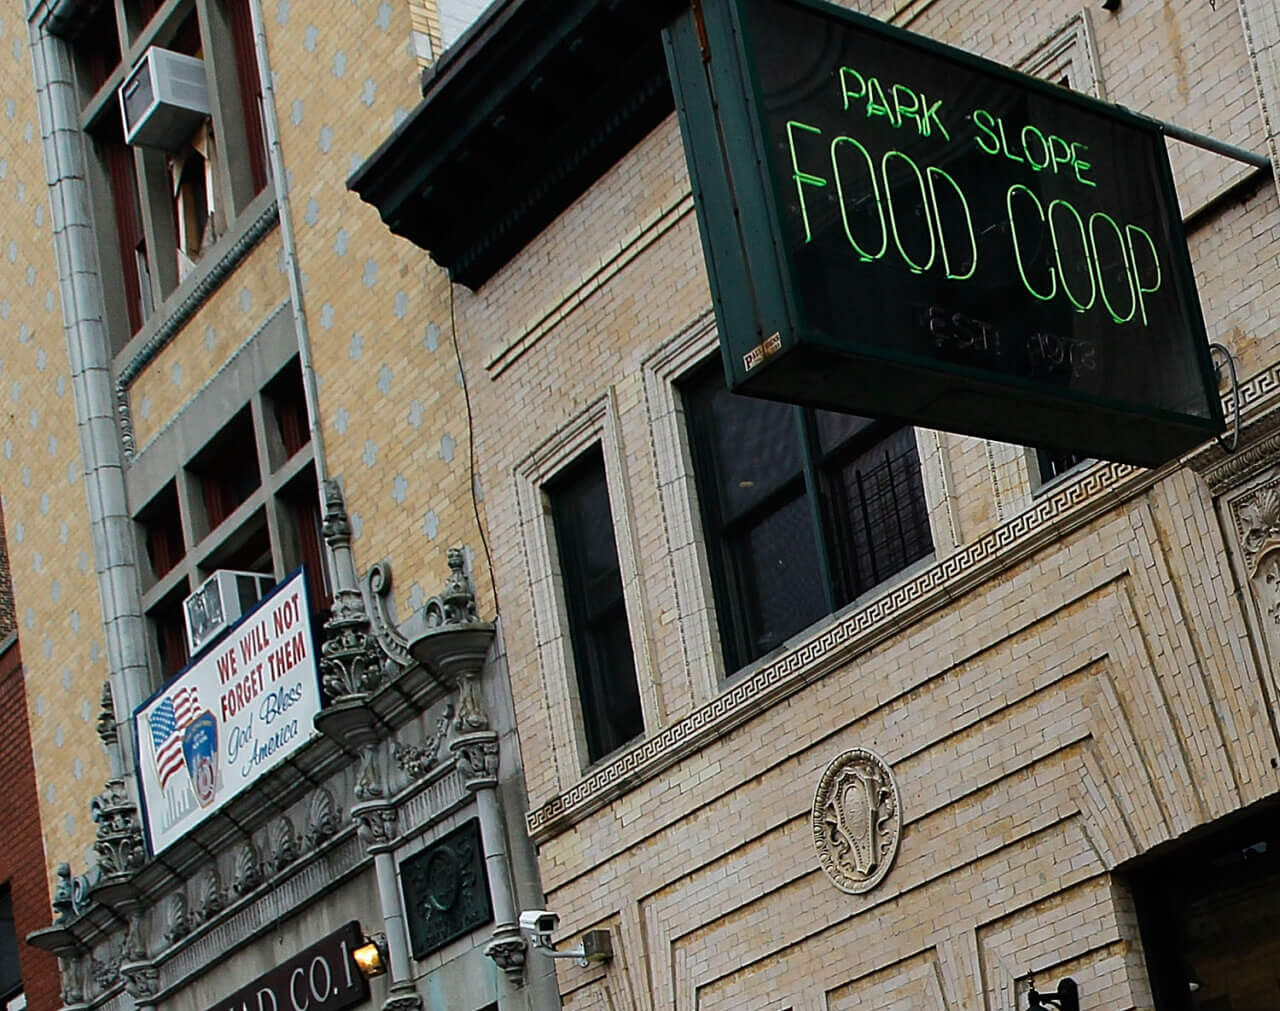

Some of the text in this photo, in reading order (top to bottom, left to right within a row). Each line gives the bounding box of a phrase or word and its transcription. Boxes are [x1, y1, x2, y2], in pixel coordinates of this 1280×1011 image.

[840, 65, 1098, 188] PARK SLOPE
[786, 120, 1163, 327] FOOD COOP
[217, 593, 300, 684] WE WILL NOT
[220, 631, 306, 722] FORGET THEM
[242, 719, 299, 777] America
[260, 681, 302, 725] Bless
